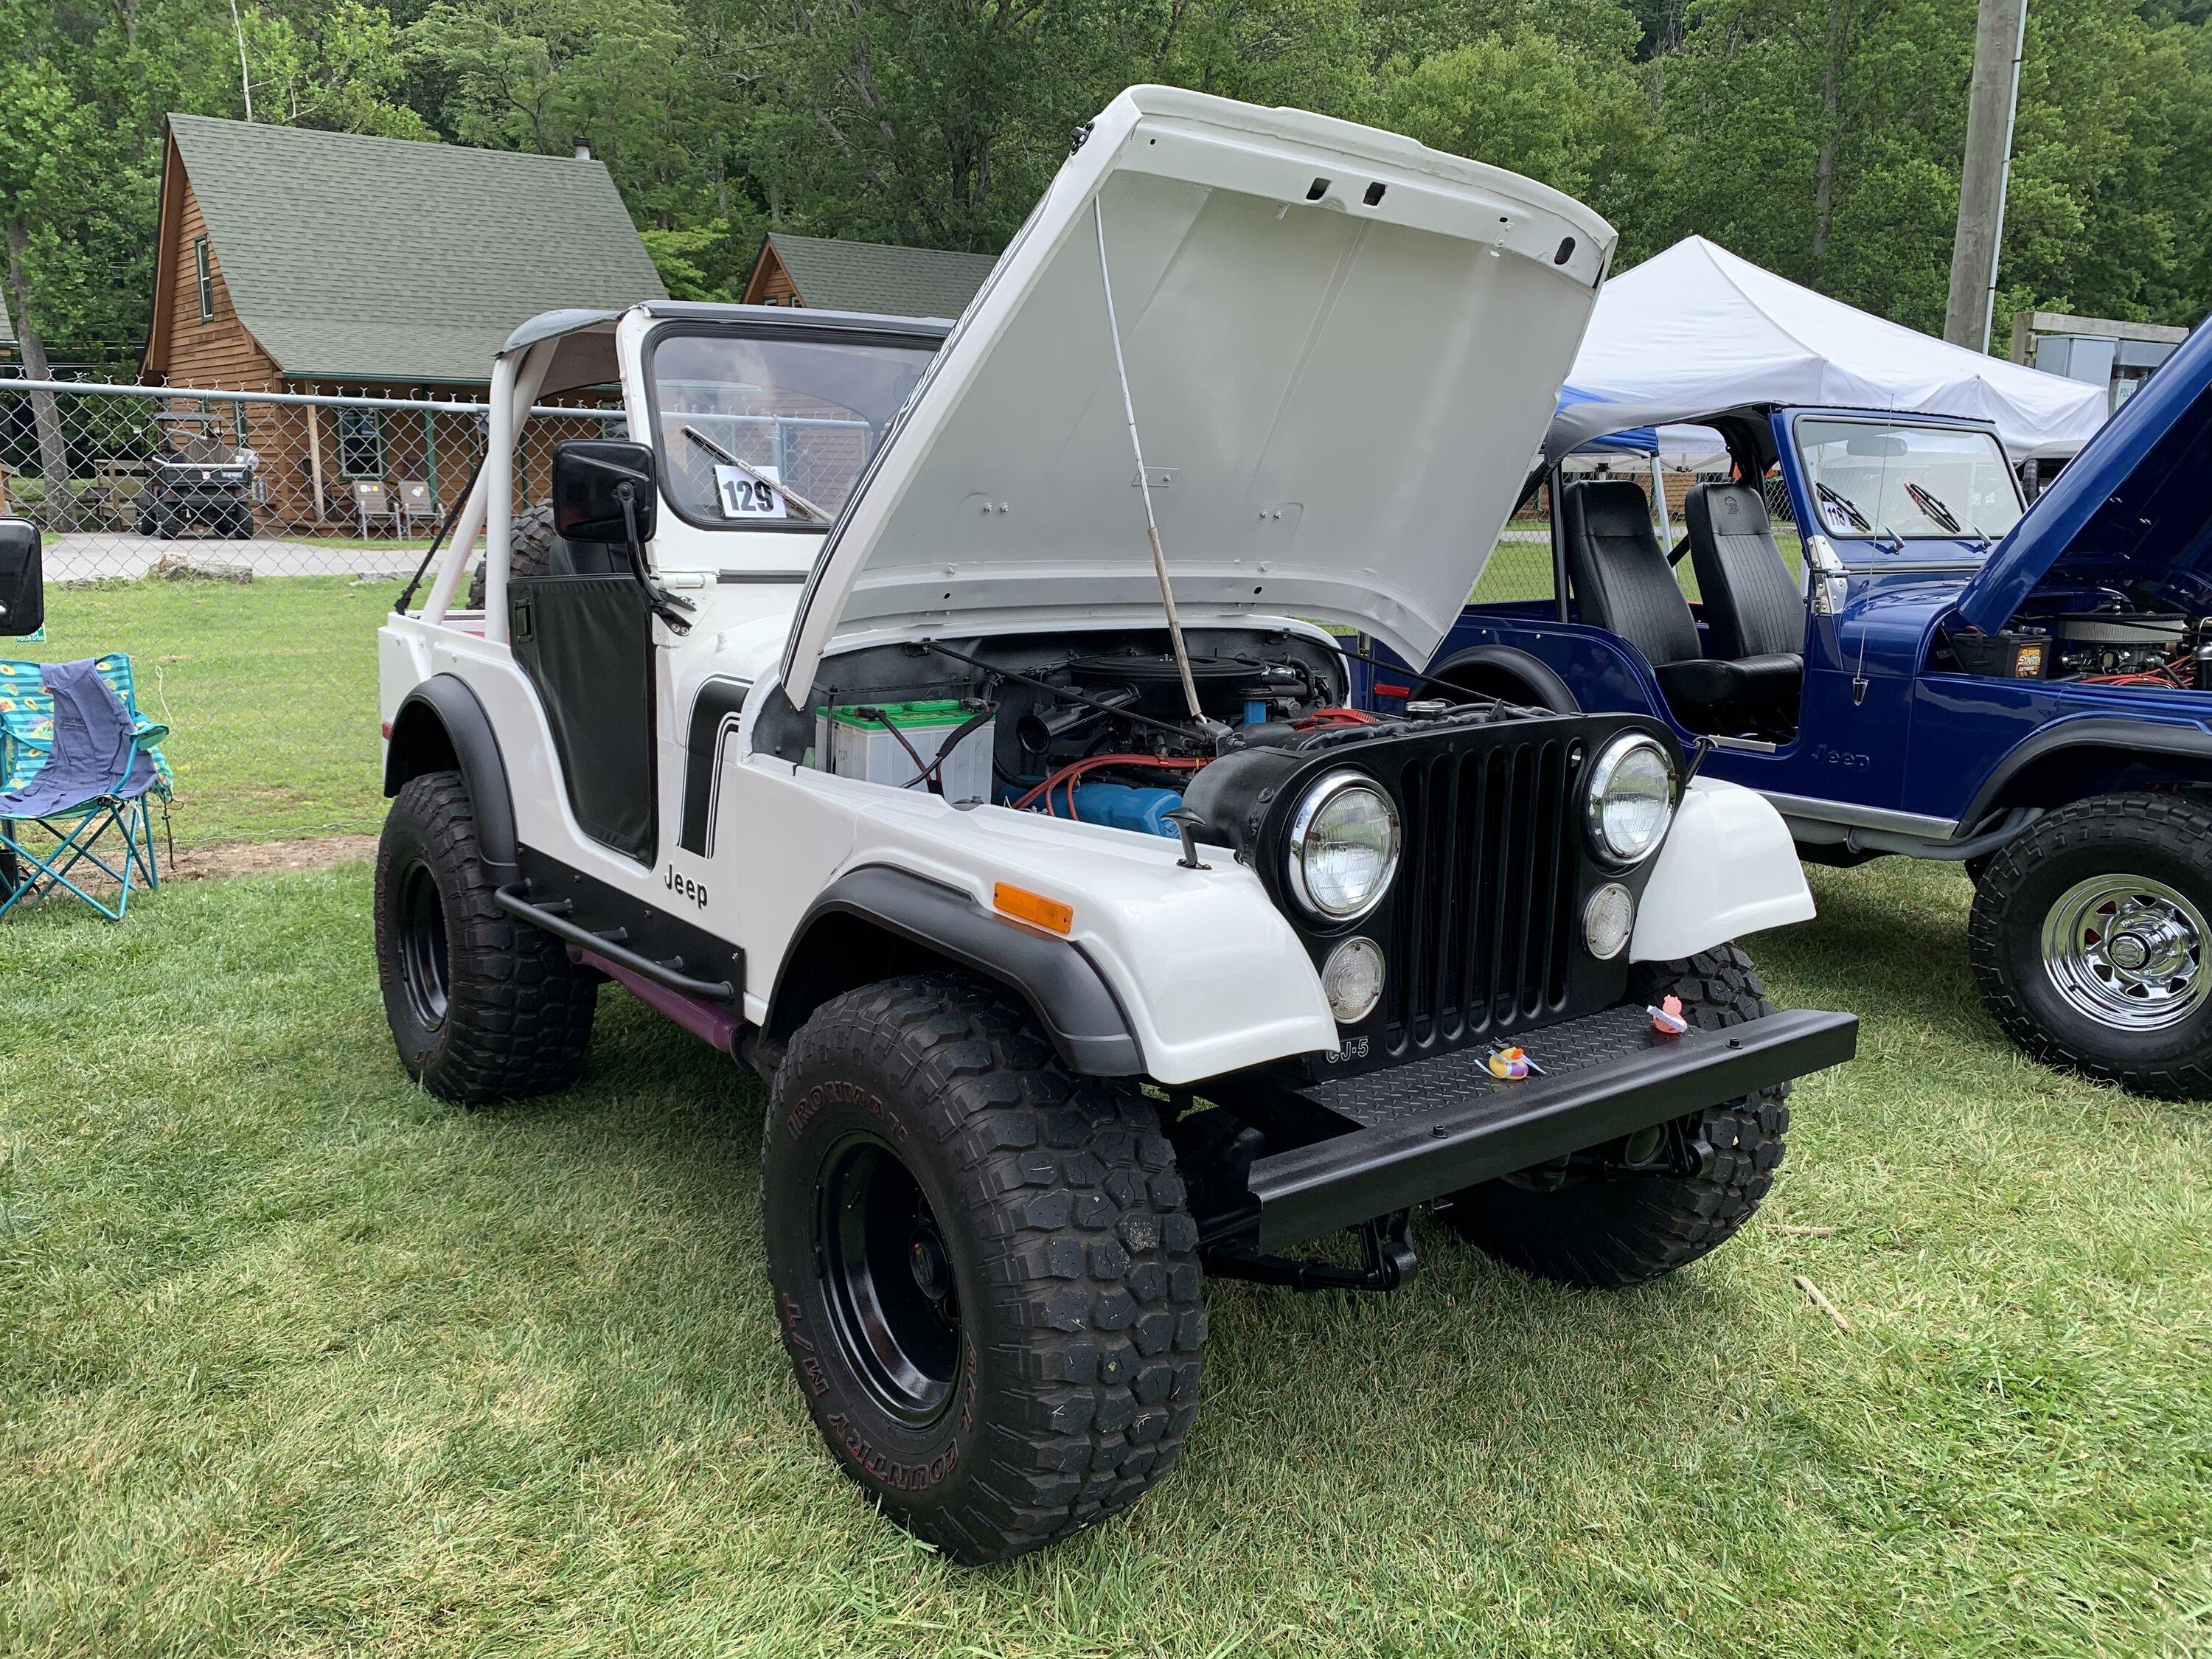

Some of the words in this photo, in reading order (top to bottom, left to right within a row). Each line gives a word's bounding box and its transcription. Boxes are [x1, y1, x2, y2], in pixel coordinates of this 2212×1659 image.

[723, 480, 774, 512] 129
[1811, 744, 1870, 772] Jeep
[664, 863, 707, 910] Jeep
[785, 1080, 908, 1143] IRONMAN
[827, 1412, 959, 1491] COUNTRY
